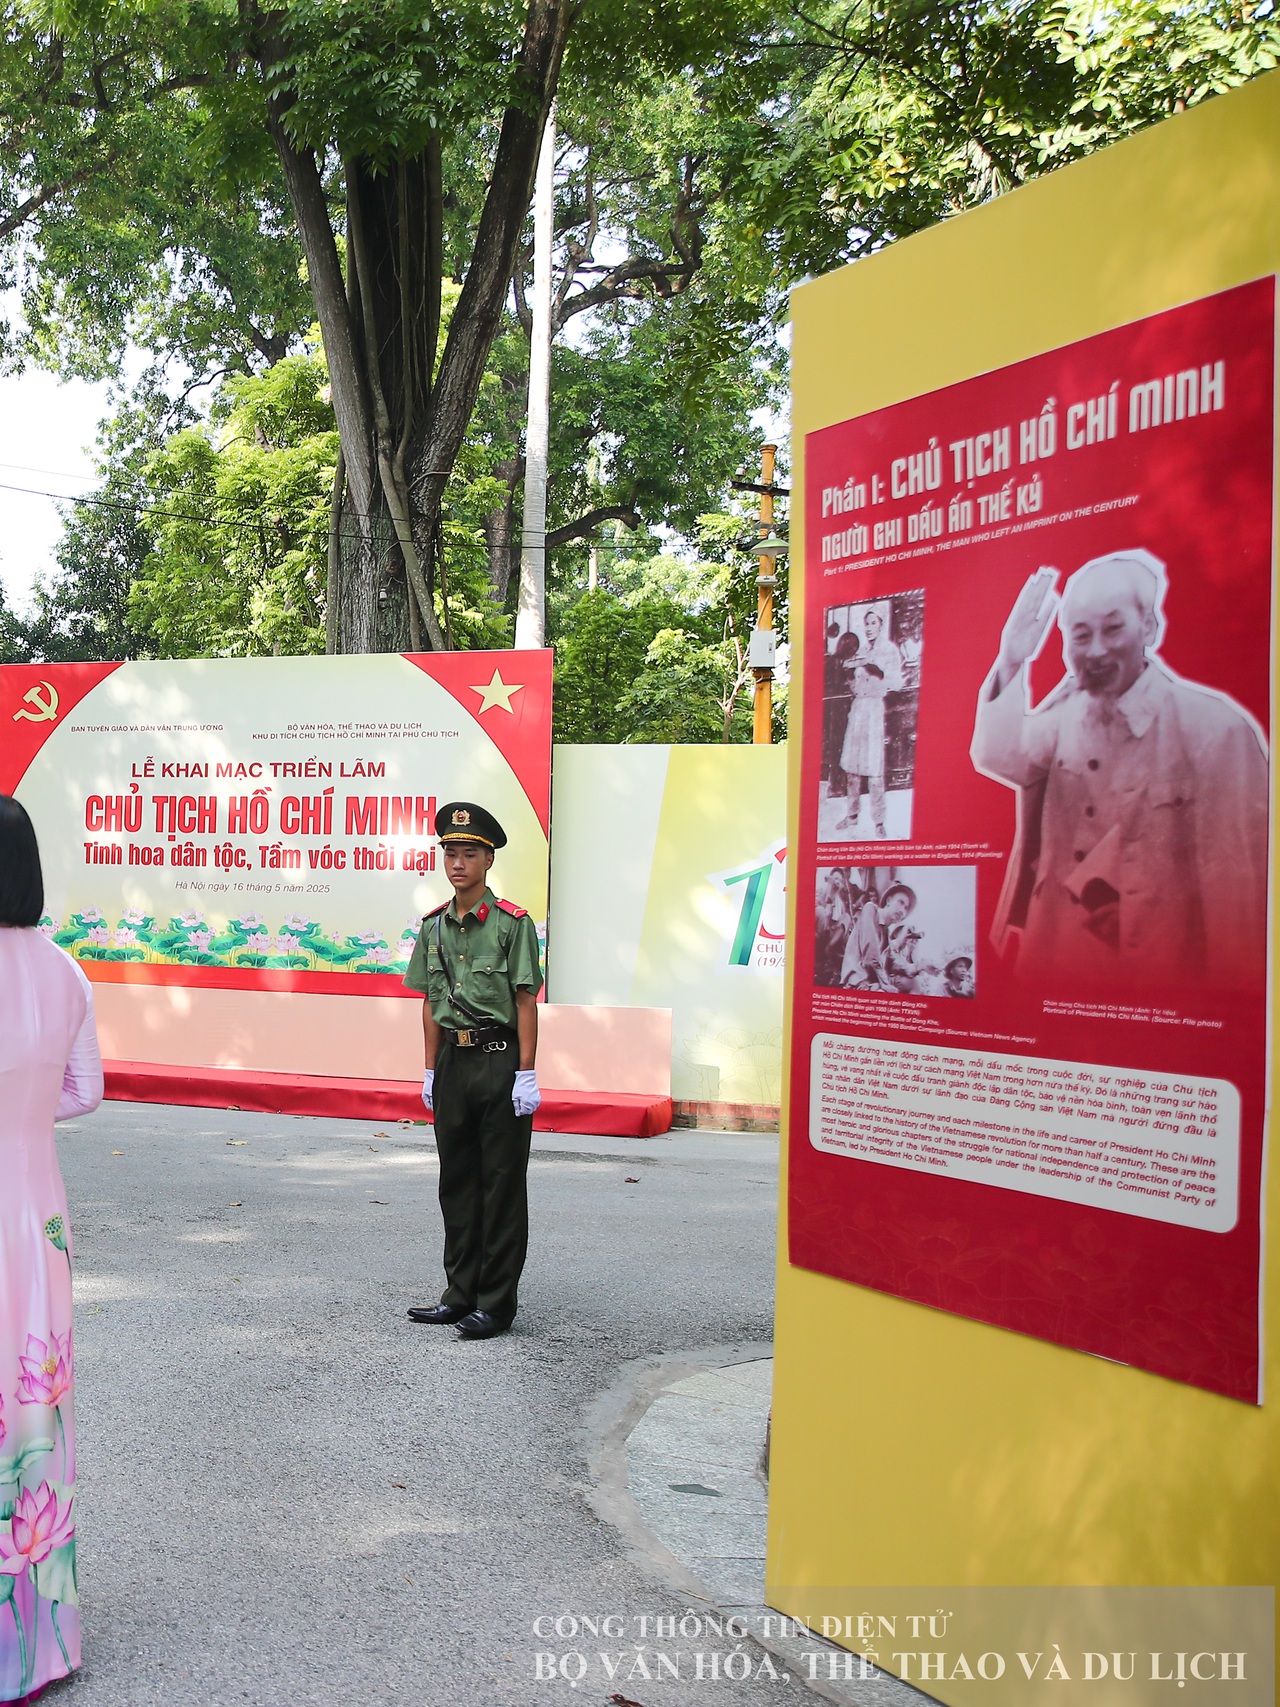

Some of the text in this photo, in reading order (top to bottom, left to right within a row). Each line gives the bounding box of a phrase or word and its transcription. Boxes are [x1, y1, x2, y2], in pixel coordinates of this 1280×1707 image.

[821, 360, 1225, 518] Phần I: CHỦ TỊCH HỒ CHÍ MINH
[822, 473, 1042, 563] NGƯỜI GHI DẤU ẤN THẾ KỶ
[823, 566, 837, 576] Part
[844, 557, 884, 571] PRESIDENT
[885, 554, 897, 563] HO
[898, 551, 911, 560] CHI
[913, 546, 934, 557] MINH,
[936, 541, 951, 551] THE
[952, 538, 970, 548] MAN
[972, 533, 989, 543] WHO
[991, 527, 1010, 539] LEFT
[1011, 525, 1022, 534] AN
[1023, 516, 1058, 531] IMPRINT
[1059, 512, 1072, 522] ON
[1074, 506, 1091, 518] THE
[1093, 495, 1138, 513] CENTURY
[131, 755, 385, 781] LỄ KHAI MẠC TRIỂN LÃM
[85, 783, 437, 841] CHỦ TỊCH HỒ CHÍ MINH
[84, 842, 436, 876] Tinh hoa dân tộc, Tầm vóc thời đại
[175, 881, 330, 893] Hà Nội ngày 16 tháng 5 năm 2025
[1043, 1007, 1066, 1016] Portrait
[1075, 1009, 1106, 1018] President
[1107, 1011, 1117, 1019] Ho
[1118, 1012, 1130, 1020] Chi
[1182, 1018, 1196, 1026] File
[1099, 1076, 1111, 1085] sự
[1115, 1078, 1146, 1089] nghiệp
[1199, 1087, 1217, 1098] tịch
[821, 1136, 948, 1167] Vietnam, led by President Ho Chi Minh.
